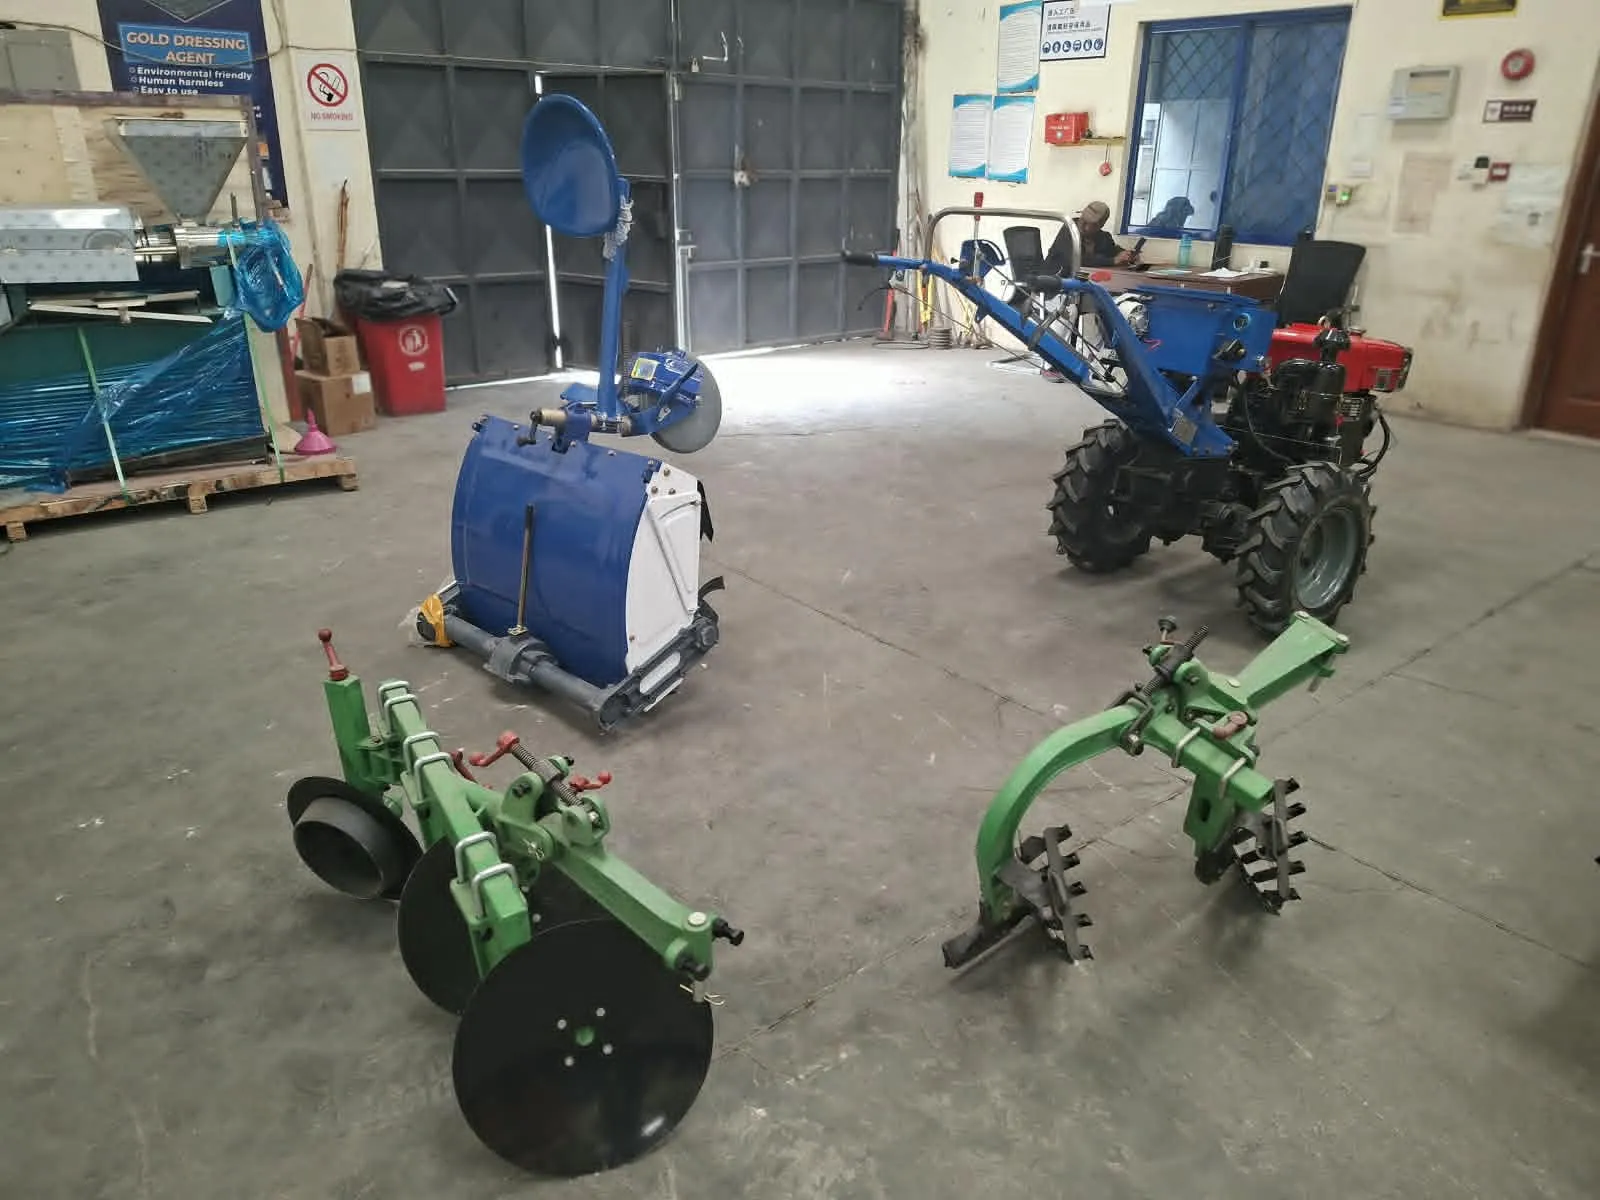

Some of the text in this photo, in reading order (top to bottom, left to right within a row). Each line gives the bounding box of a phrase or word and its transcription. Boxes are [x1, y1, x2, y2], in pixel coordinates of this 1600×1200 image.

[127, 31, 246, 50] GOLD DRESSING
[166, 51, 216, 64] AGENT
[137, 66, 252, 80] Environmental friendly
[138, 76, 224, 87] Human harmless
[311, 111, 353, 121] NO SMOKING
